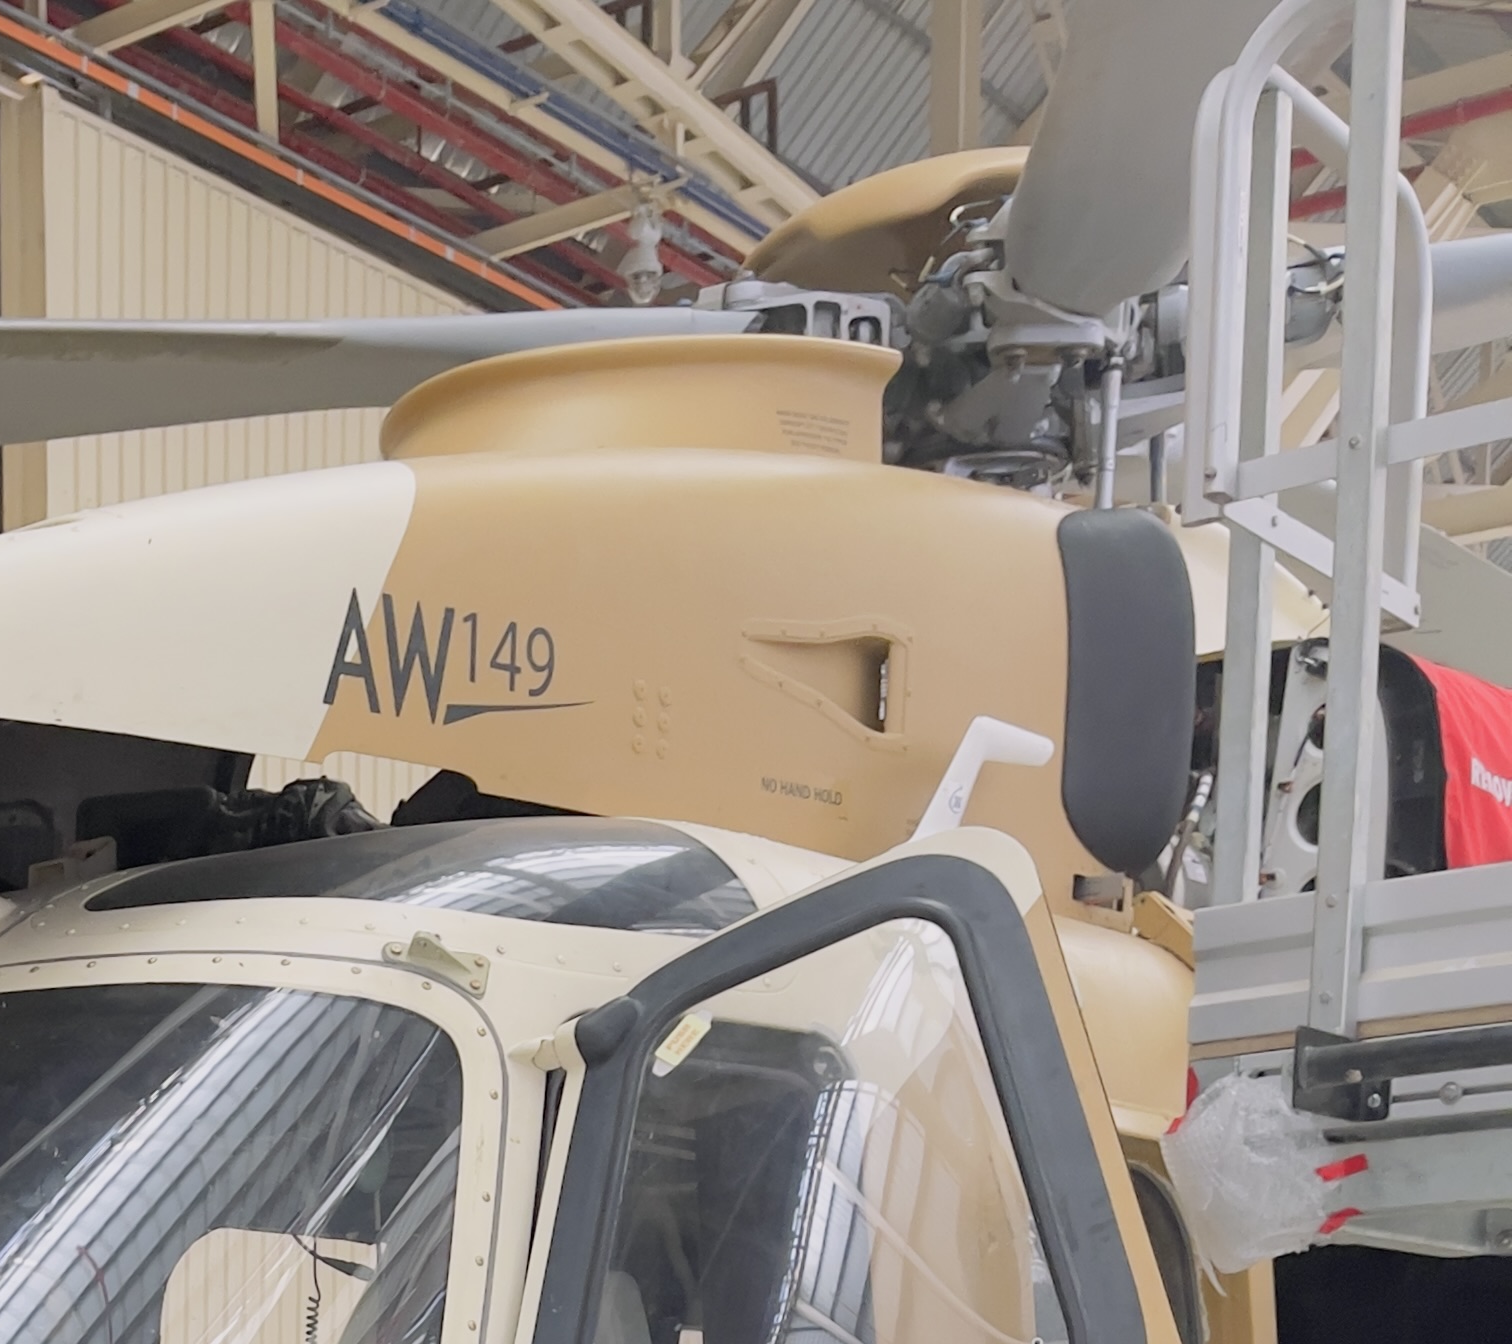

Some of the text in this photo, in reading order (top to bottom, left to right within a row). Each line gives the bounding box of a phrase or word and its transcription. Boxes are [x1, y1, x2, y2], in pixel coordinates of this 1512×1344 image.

[761, 776, 843, 806] NO HAND HOLD
